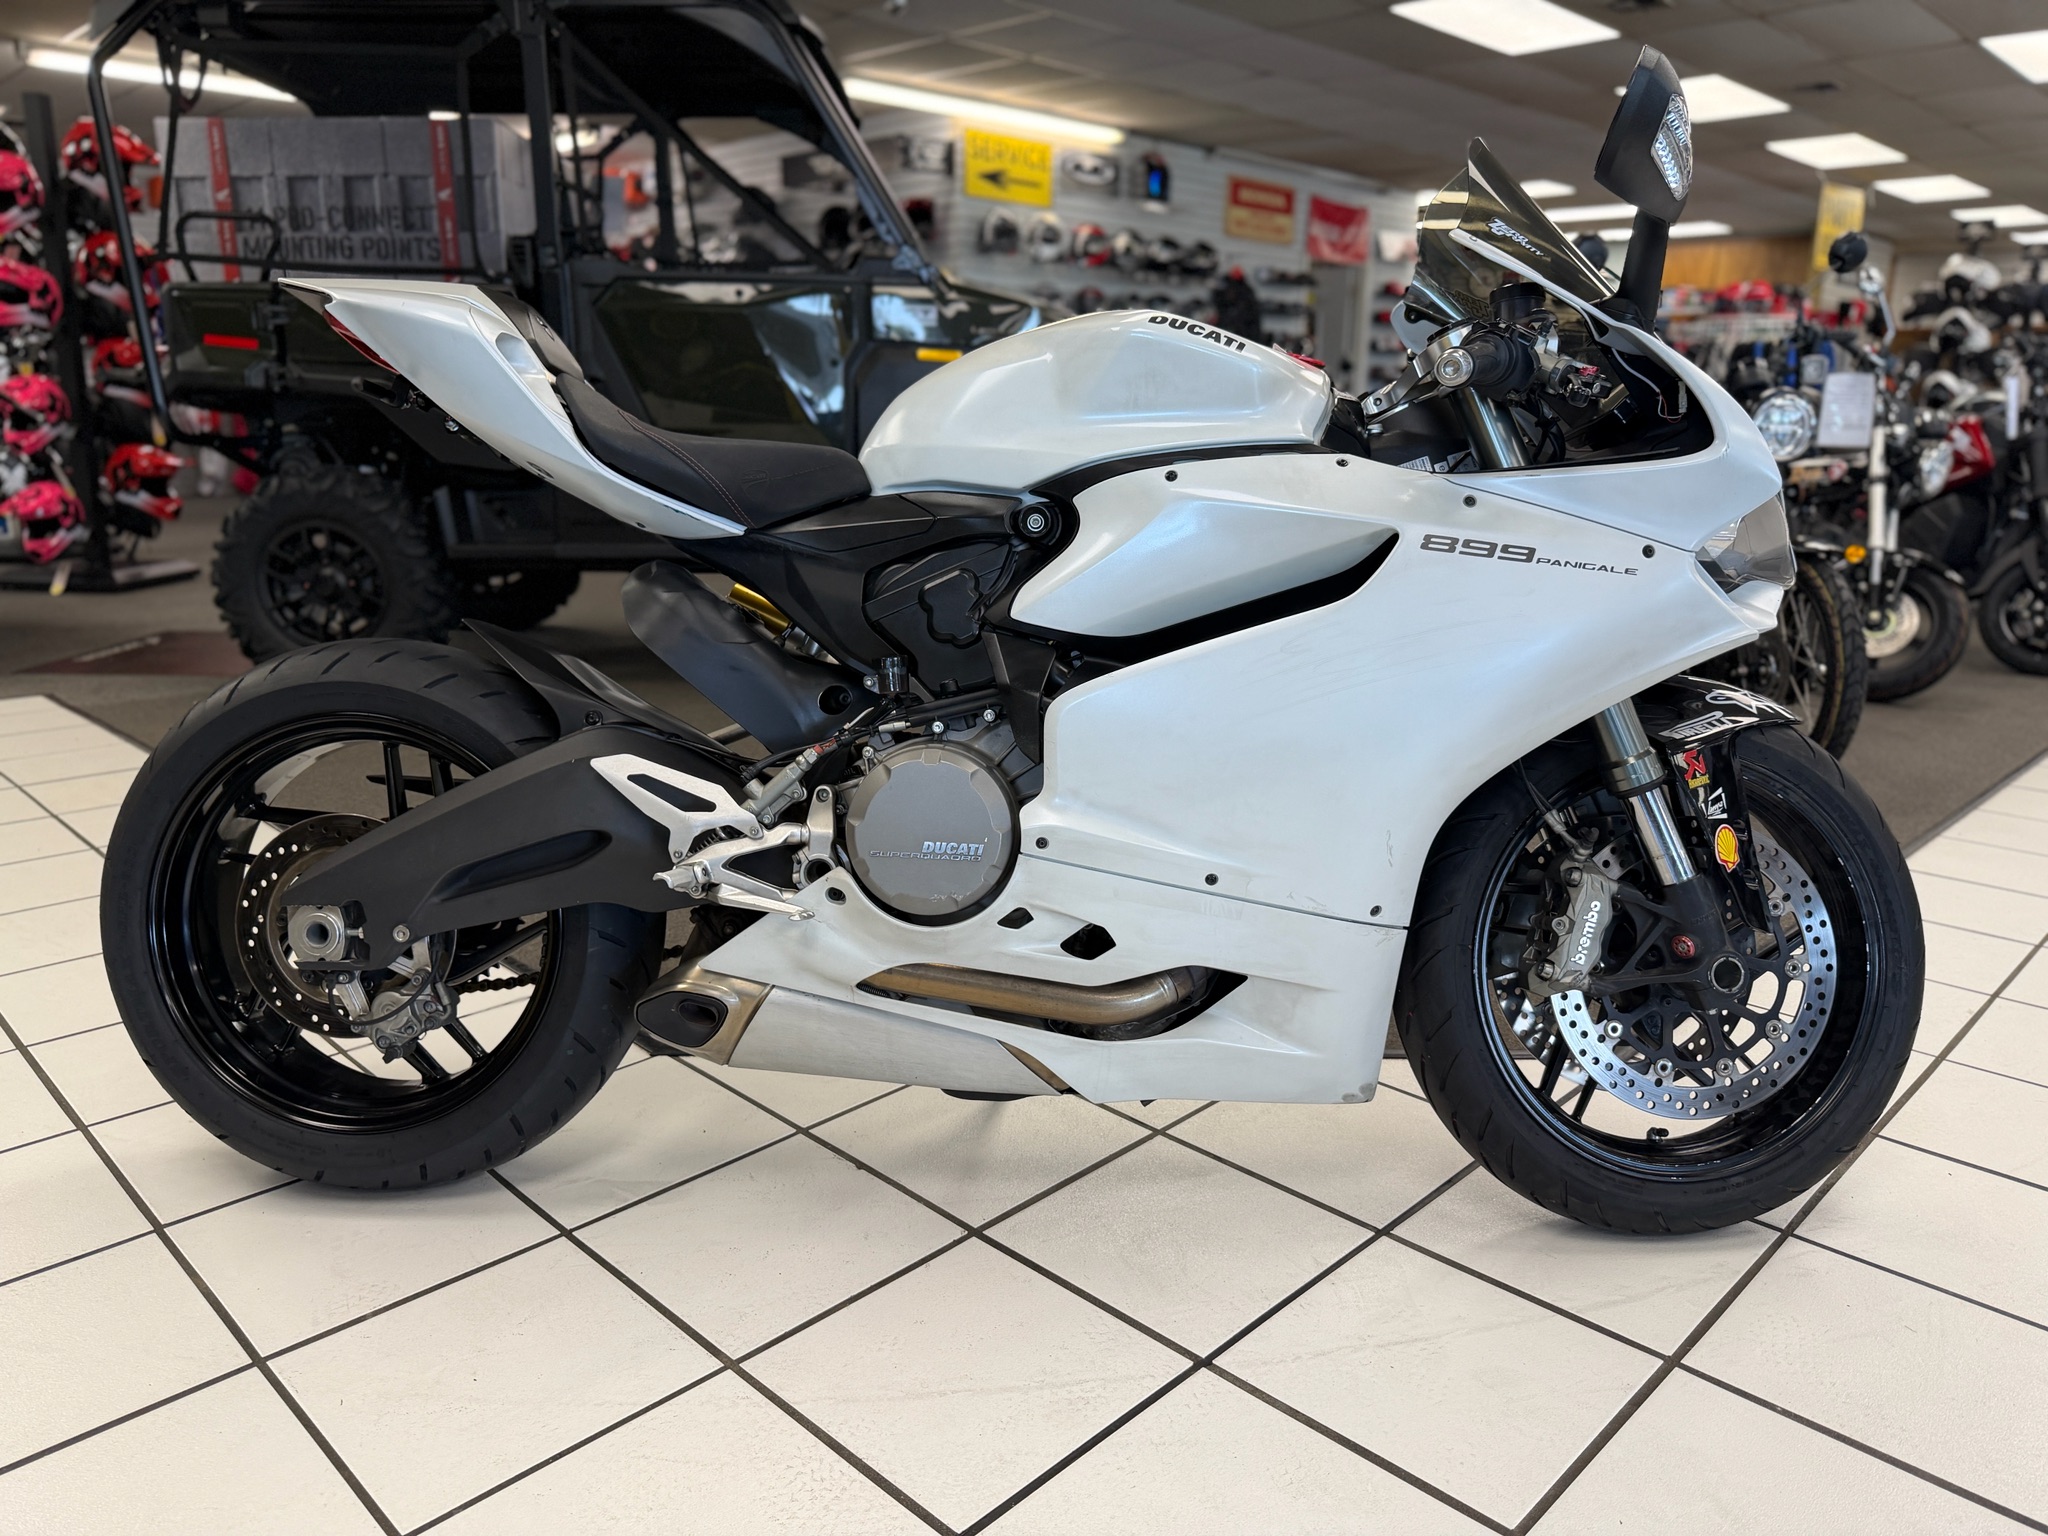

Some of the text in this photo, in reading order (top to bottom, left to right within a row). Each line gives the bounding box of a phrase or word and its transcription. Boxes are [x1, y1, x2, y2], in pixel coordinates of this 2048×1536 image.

[362, 236, 441, 262] POINTS
[1148, 315, 1246, 353] DUCATI
[1420, 533, 1639, 576] 899 PANIGALE
[869, 850, 982, 862] SUPERQUADRO
[922, 841, 985, 856] DUCATI
[1570, 900, 1601, 966] brembo
